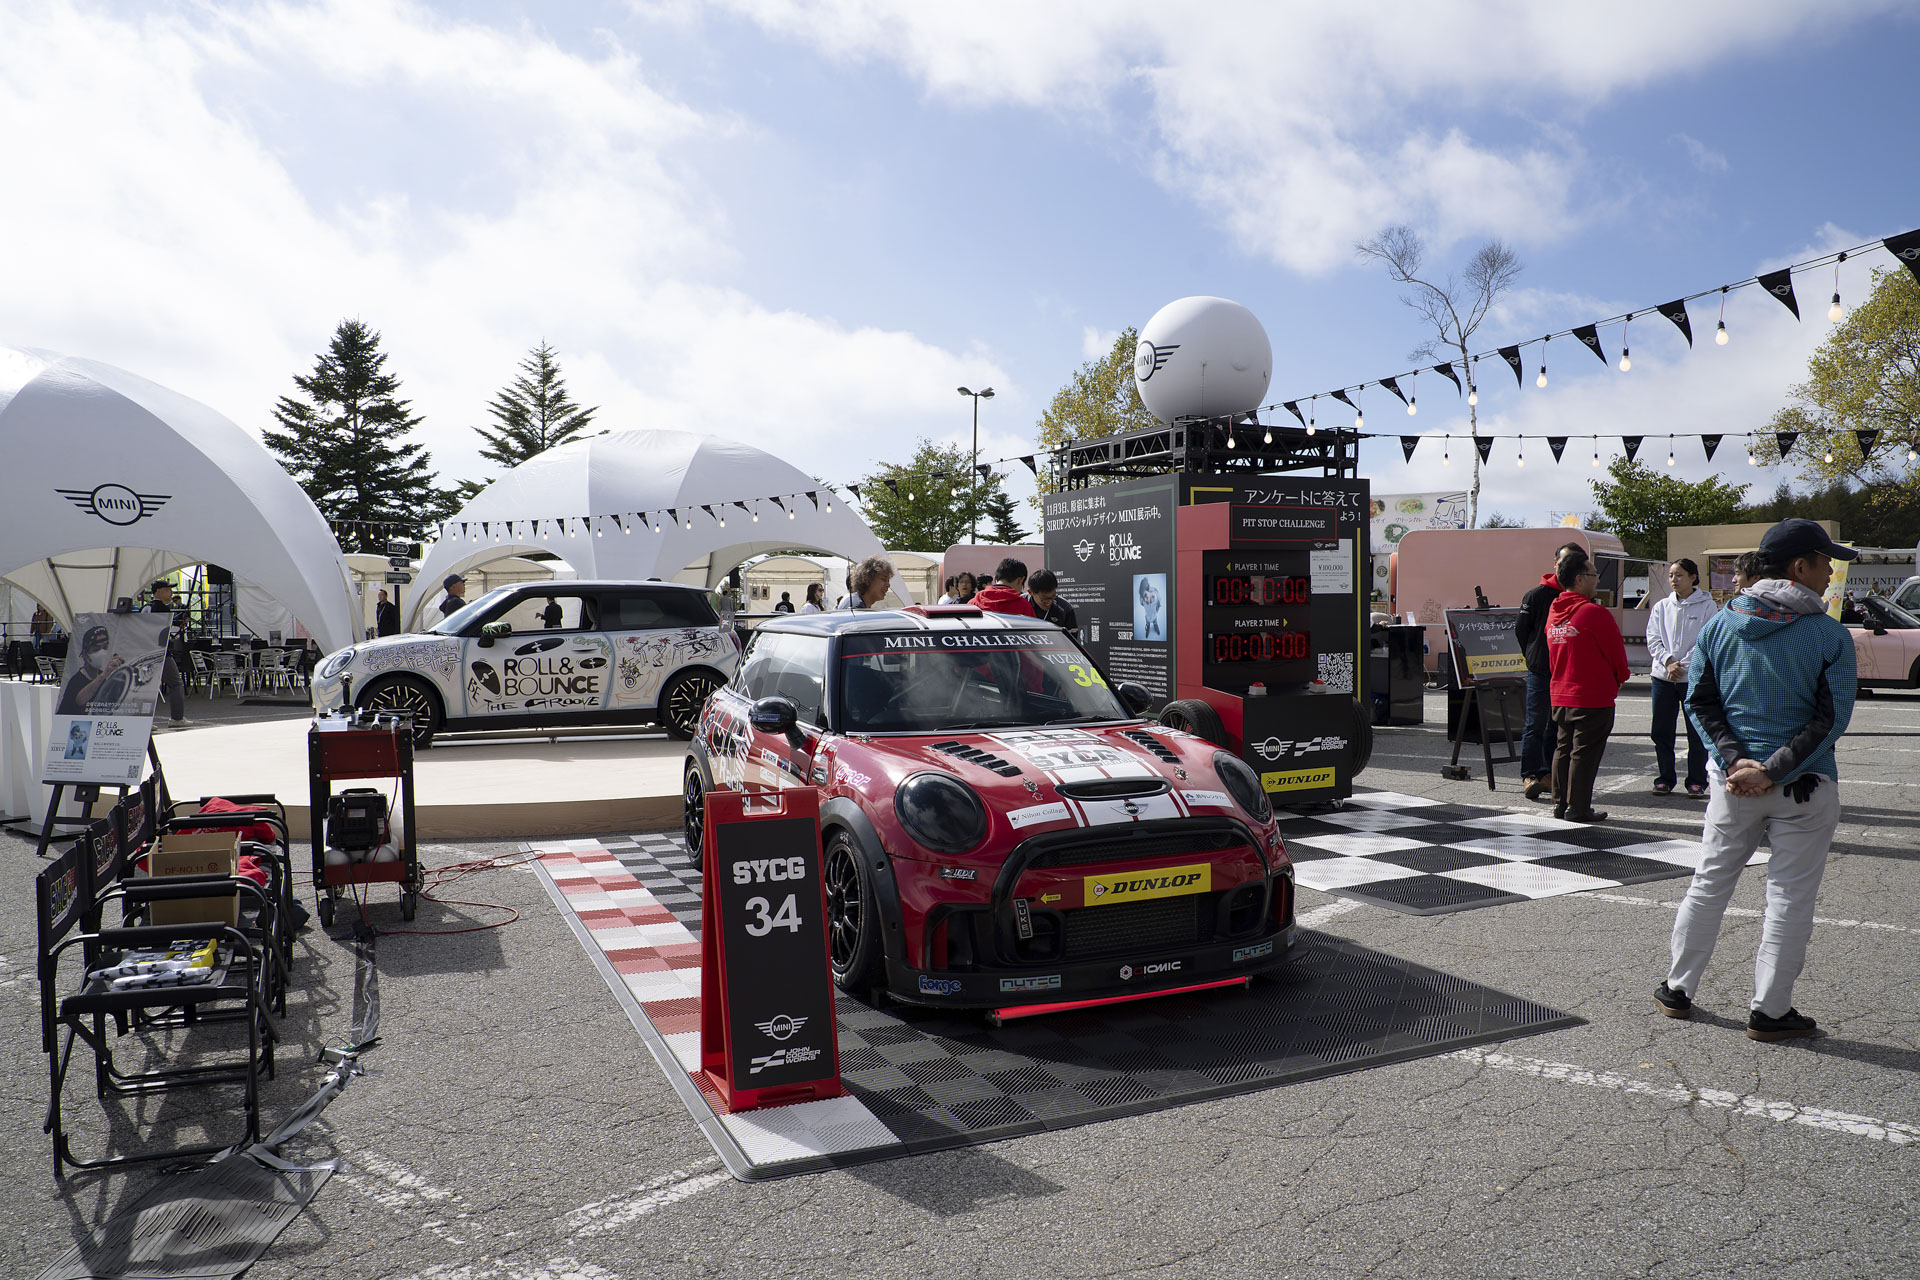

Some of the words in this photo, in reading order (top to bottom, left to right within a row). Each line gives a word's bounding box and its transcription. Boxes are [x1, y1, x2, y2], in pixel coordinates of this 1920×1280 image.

[98, 498, 137, 511] MINI
[1244, 489, 1361, 507] アンケートに答えて
[1046, 496, 1106, 516] 11月3日、原宿に集まれ
[1242, 518, 1256, 527] PIT
[1257, 519, 1278, 528] STOP
[1279, 519, 1326, 529] CHALLENGE
[1109, 546, 1142, 561] BOUNCE
[1234, 563, 1258, 571] PLAYER
[1264, 563, 1280, 571] TIME
[1234, 619, 1258, 628] PLAYER
[1264, 619, 1280, 627] TIME
[884, 636, 936, 649] MINI
[941, 634, 1054, 648] CHALLENGE
[1479, 633, 1505, 642] supported
[1216, 634, 1306, 660] 00:00:00
[405, 653, 461, 672] PEOPLE
[504, 656, 575, 677] ROLL&
[1480, 658, 1524, 668] DUNLOP
[1068, 665, 1108, 690] 34
[468, 677, 482, 703] BE
[504, 675, 600, 696] BOUNCE
[485, 699, 518, 713] THE
[524, 696, 600, 708] GROOVE
[96, 728, 125, 737] BOUNCE
[1027, 750, 1121, 768] SYCG
[1276, 773, 1330, 786] DUNLOP
[1021, 811, 1041, 820] Nihon
[732, 856, 806, 885] SYCG
[1110, 873, 1202, 895] DUNLOP
[744, 893, 803, 937] 34
[1017, 901, 1030, 931] LUKE
[773, 1023, 791, 1032] MINI
[786, 1049, 821, 1059] COOPER
[787, 1046, 810, 1054] JOHN
[785, 1055, 817, 1064] WORKS
